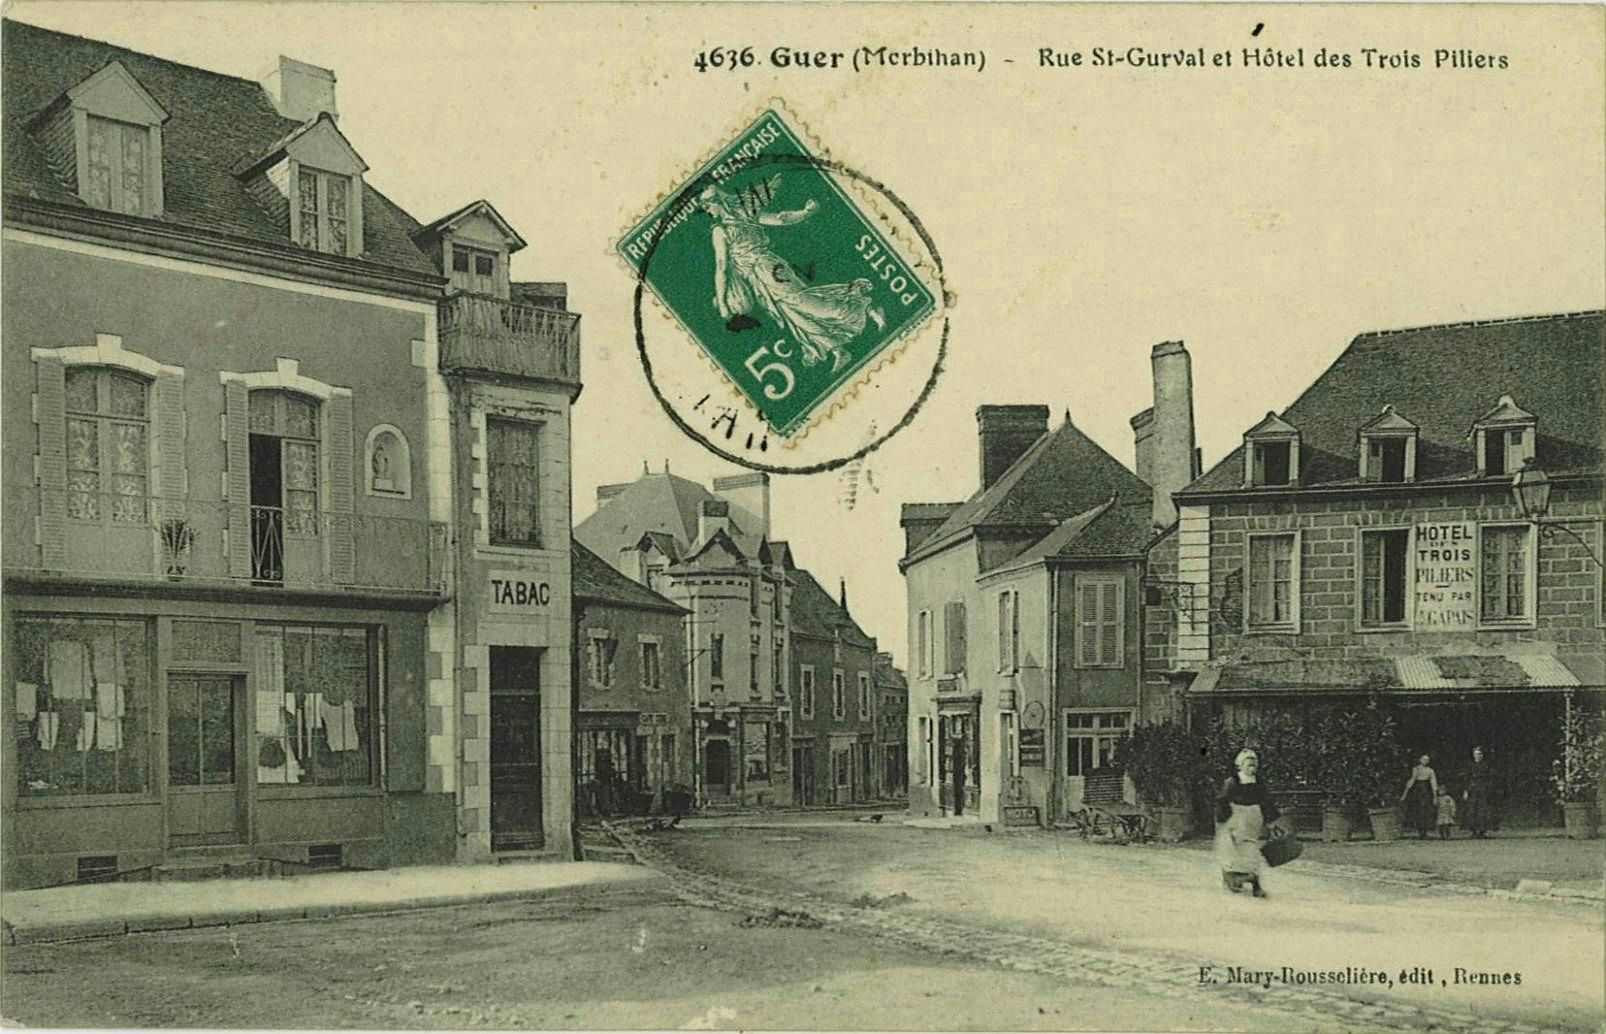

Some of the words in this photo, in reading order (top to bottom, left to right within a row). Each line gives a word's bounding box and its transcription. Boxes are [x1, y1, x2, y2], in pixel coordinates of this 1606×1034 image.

[712, 121, 781, 185] FRANÇAISE
[855, 235, 918, 306] POSTES
[1416, 525, 1473, 541] HOTEL
[1419, 549, 1471, 561] TROIS
[1416, 567, 1475, 583] PILIERS
[491, 580, 550, 606] TABAC
